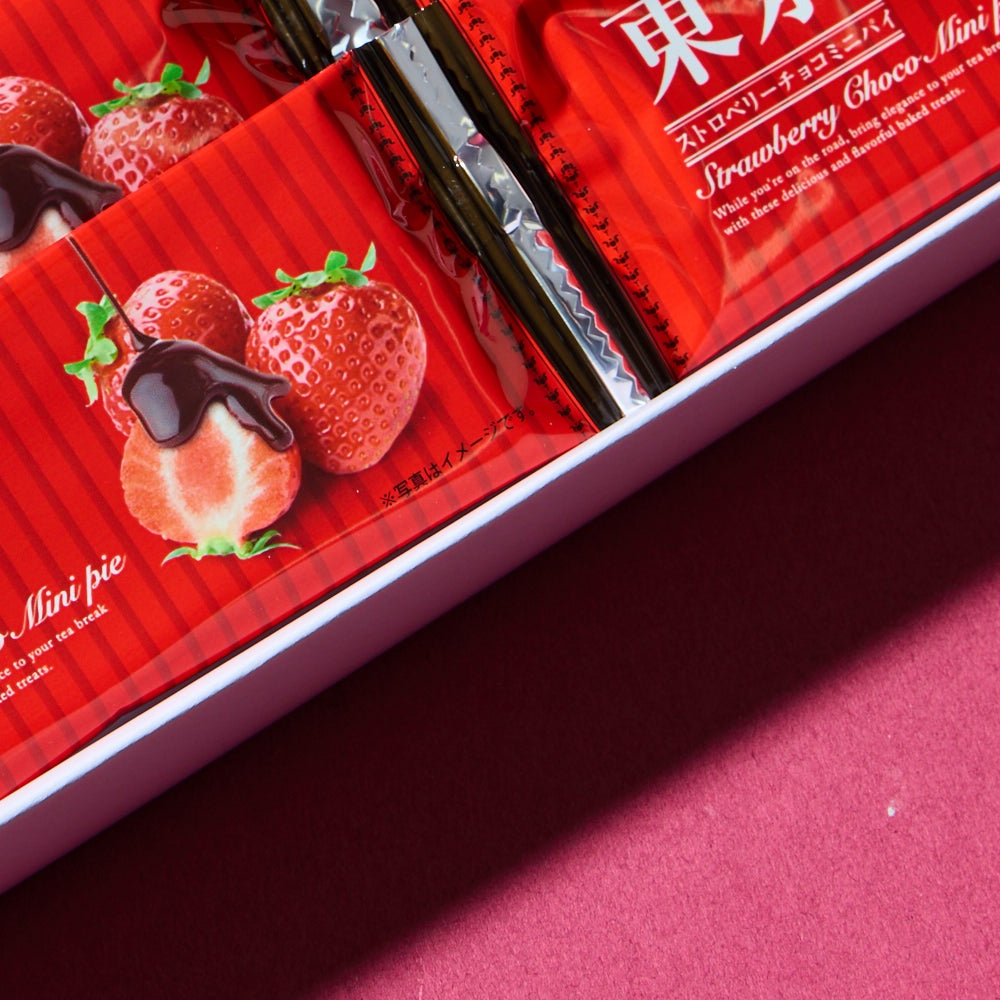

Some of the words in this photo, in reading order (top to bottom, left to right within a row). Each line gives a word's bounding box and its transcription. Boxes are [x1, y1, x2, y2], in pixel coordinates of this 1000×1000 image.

[675, 9, 896, 153] ストロベリーチョコミニパイ
[695, 104, 838, 200] Strawberry
[843, 55, 921, 110] Choco
[923, 4, 989, 64] Mini
[712, 196, 750, 220] While
[785, 165, 802, 178] on
[801, 153, 821, 169] the
[821, 134, 850, 157] road,
[848, 116, 882, 139] bring
[880, 88, 926, 120] elegance
[926, 80, 940, 92] to
[940, 63, 965, 87] your
[965, 53, 984, 68] tea
[723, 216, 750, 236] with
[750, 199, 780, 220] these
[781, 169, 829, 202] delicious
[831, 152, 851, 172] and
[851, 124, 897, 159] flavorful
[895, 104, 930, 131] baked
[930, 88, 962, 110] treats.
[9, 575, 78, 640] Mini
[77, 554, 126, 607] pie
[12, 658, 27, 670] to
[27, 639, 54, 664] your
[55, 627, 75, 642] tea
[73, 604, 109, 630] break
[15, 665, 54, 690] treats.
